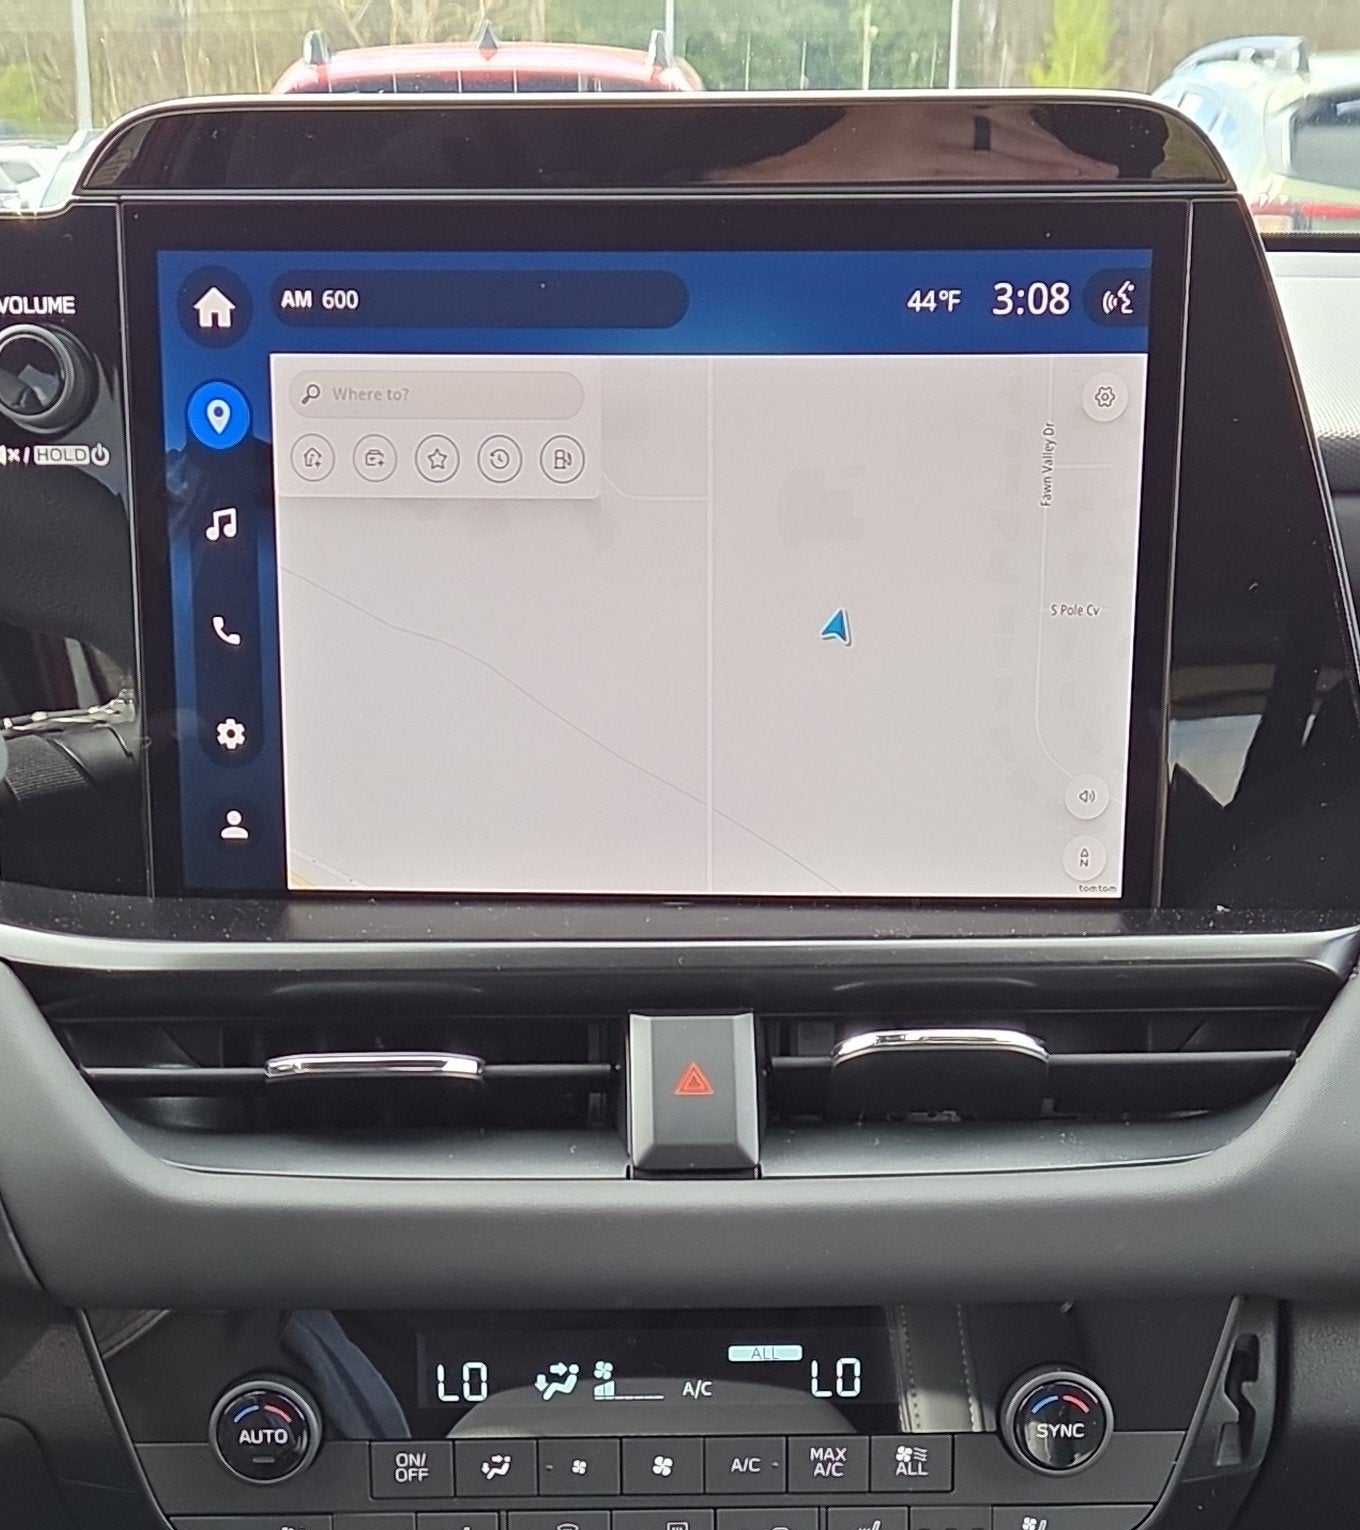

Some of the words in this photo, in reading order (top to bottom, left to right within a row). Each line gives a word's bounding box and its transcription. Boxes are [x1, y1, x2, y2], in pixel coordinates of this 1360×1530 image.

[280, 289, 313, 309] AM
[322, 289, 359, 310] 600
[906, 289, 962, 313] 44°F
[992, 281, 1070, 316] 3:08
[332, 387, 382, 401] Where
[386, 387, 409, 401] to?
[1043, 422, 1055, 437] Dr
[36, 447, 88, 462] HOLD
[1041, 438, 1058, 474] Valley
[1040, 475, 1052, 507] Fawn
[1050, 604, 1057, 616] S
[1060, 604, 1084, 616] Pole
[1086, 604, 1100, 616] Cv
[750, 1346, 780, 1361] ALL
[681, 1379, 713, 1401] A/C
[238, 1428, 289, 1445] AUTO
[1036, 1422, 1086, 1439] SYNC
[395, 1452, 428, 1468] ON/
[809, 1447, 848, 1462] MAX
[730, 1457, 762, 1474] A/C
[813, 1462, 844, 1478] A/C
[894, 1462, 929, 1477] ALL
[394, 1467, 430, 1483] OFF
